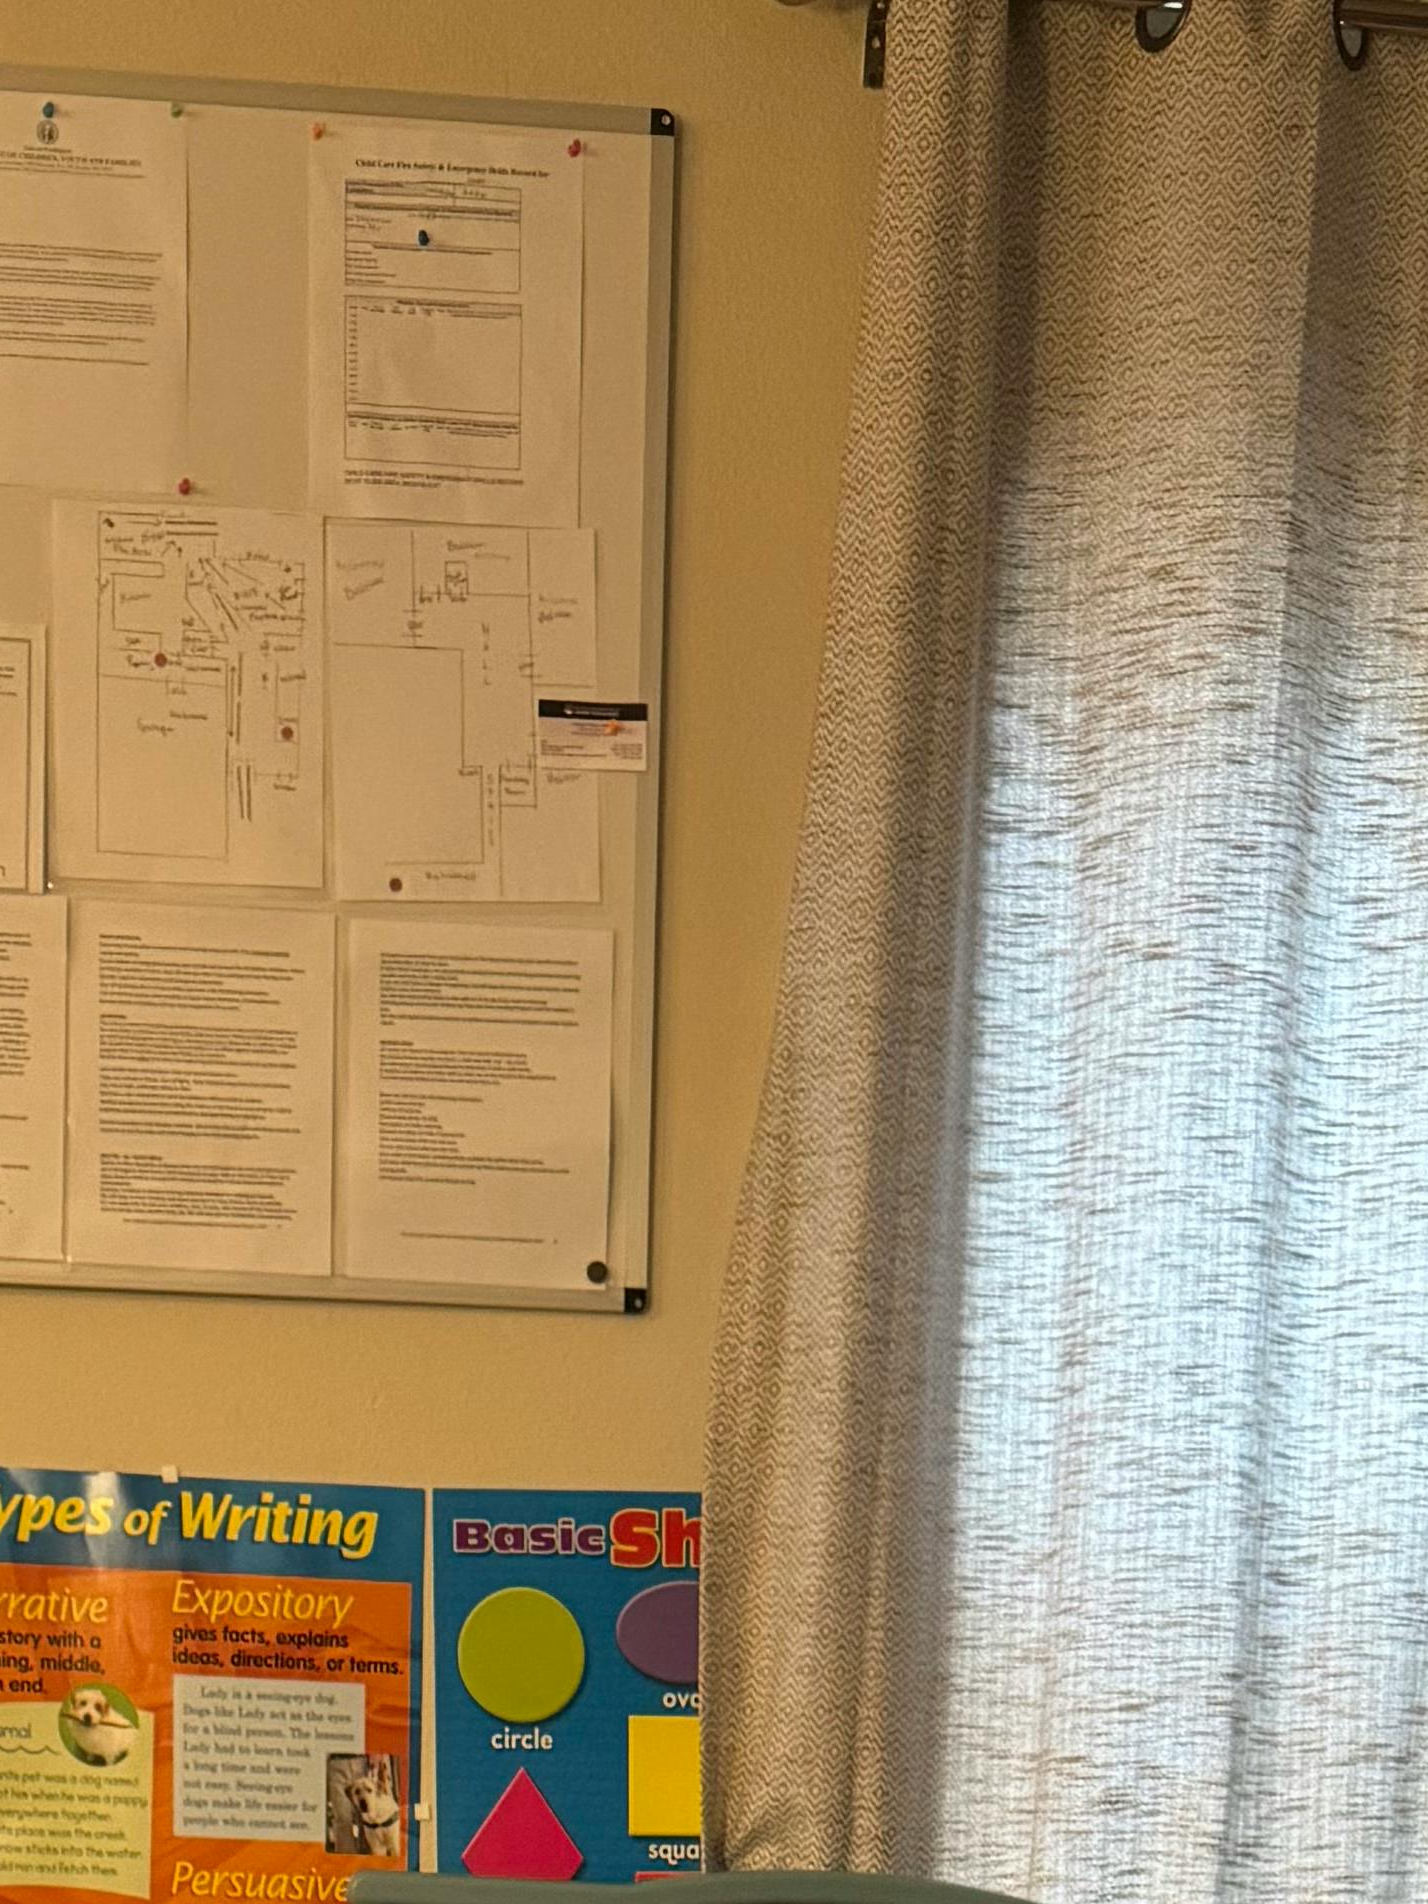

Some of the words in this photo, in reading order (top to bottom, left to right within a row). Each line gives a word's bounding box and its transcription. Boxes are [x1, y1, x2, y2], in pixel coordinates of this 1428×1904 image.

[123, 1501, 172, 1545] of
[180, 1490, 378, 1559] Writing
[453, 1518, 604, 1556] Basic
[172, 1579, 354, 1628] Expository
[47, 1630, 83, 1648] with
[90, 1636, 101, 1648] a
[173, 1626, 217, 1645] gives
[223, 1627, 270, 1645] facts,
[276, 1630, 348, 1649] explains
[40, 1655, 105, 1675] middle,
[173, 1648, 224, 1667] ideas,
[230, 1650, 320, 1671] directions,
[326, 1657, 344, 1670] or
[350, 1656, 404, 1675] terms.
[9, 1678, 47, 1693] end.
[490, 1727, 554, 1752] circle
[172, 1861, 350, 1902] Persuasive
